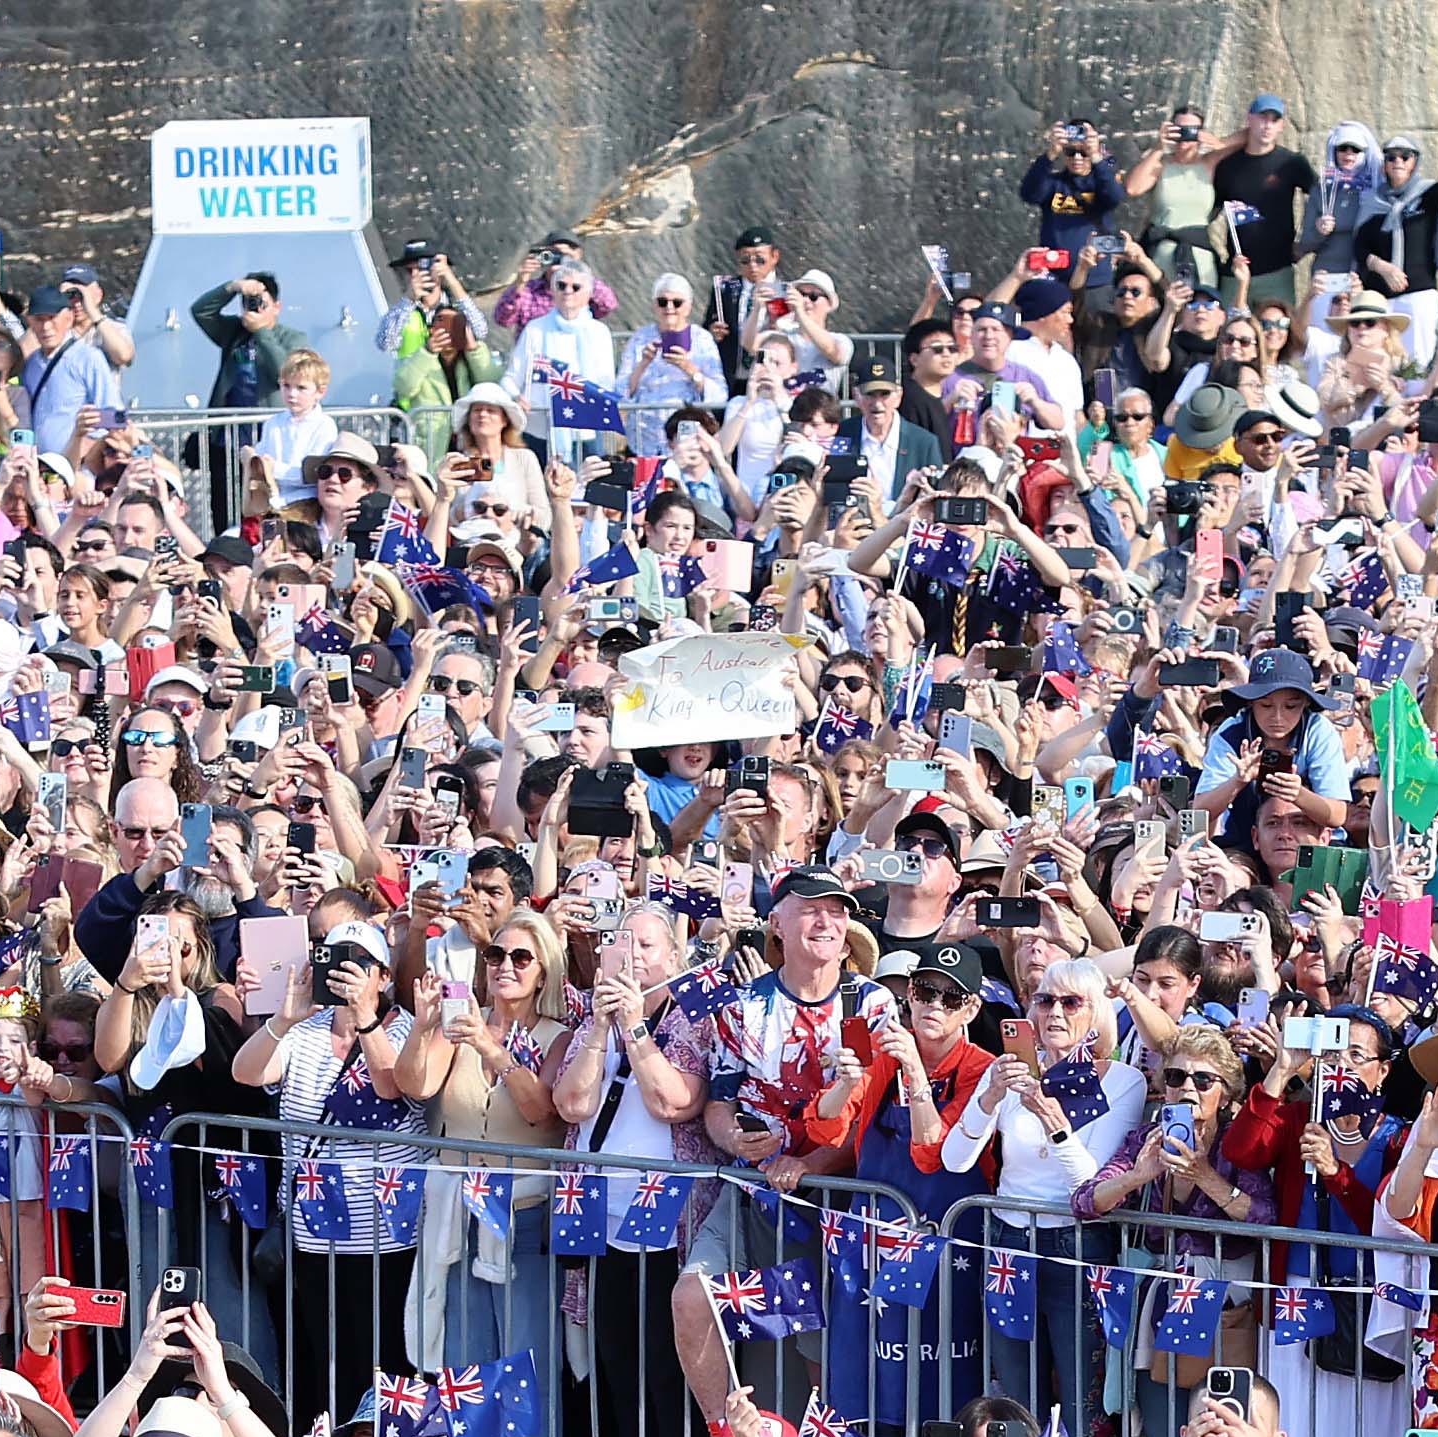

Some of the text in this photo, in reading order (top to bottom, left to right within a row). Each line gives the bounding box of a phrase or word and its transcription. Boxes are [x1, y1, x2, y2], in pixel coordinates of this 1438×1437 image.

[175, 144, 338, 178] DRINKING
[200, 185, 317, 218] WATER
[691, 649, 769, 677] Austral
[647, 692, 694, 721] King
[720, 679, 793, 713] Queen
[874, 1339, 978, 1361] USRLIA
